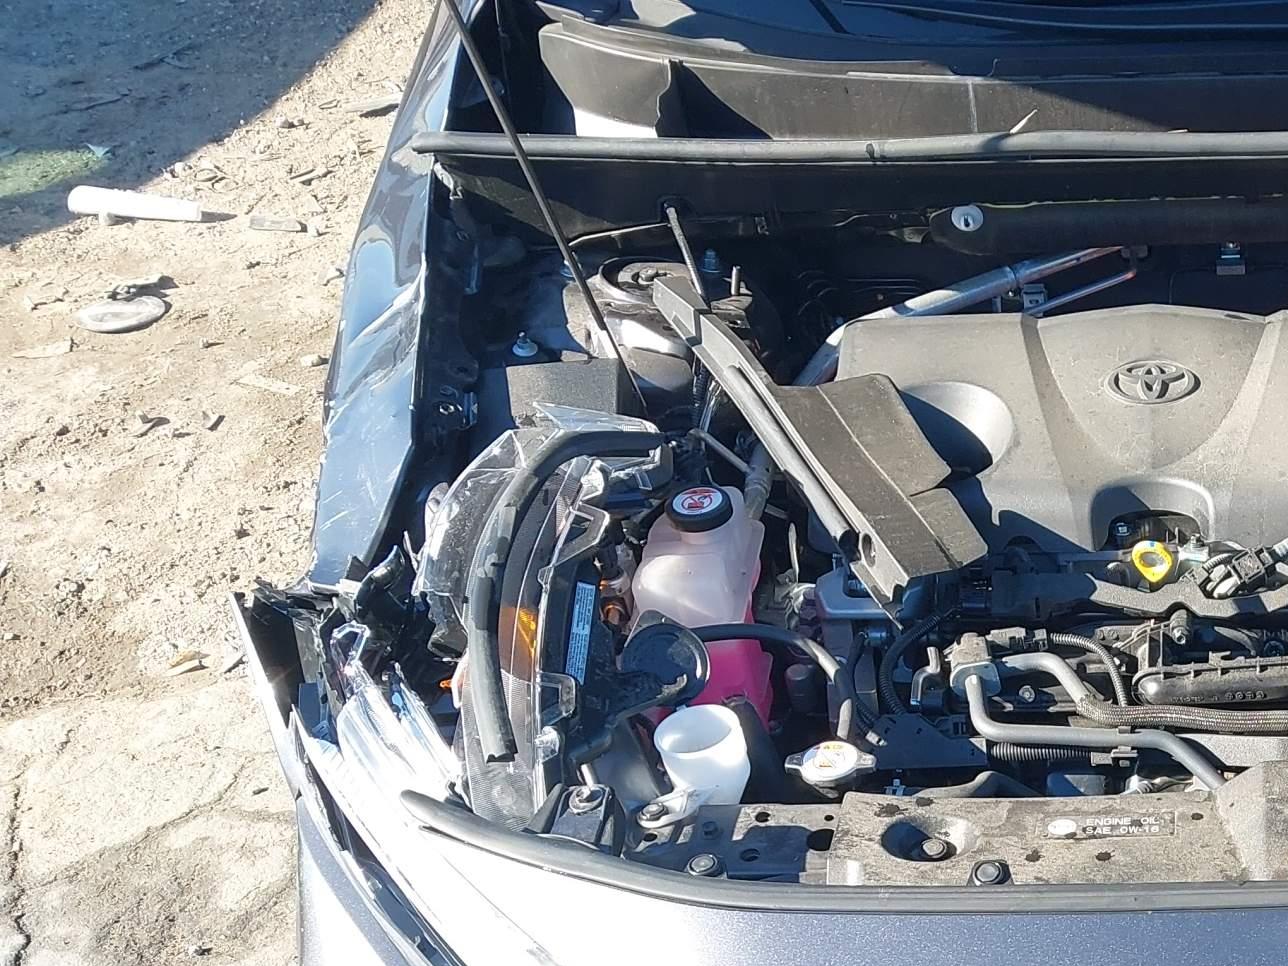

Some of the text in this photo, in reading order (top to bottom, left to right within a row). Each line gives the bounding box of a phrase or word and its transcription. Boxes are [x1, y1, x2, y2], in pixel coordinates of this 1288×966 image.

[1086, 816, 1160, 826] ENGINE OIL
[1085, 825, 1160, 834] SAE 0W-16
